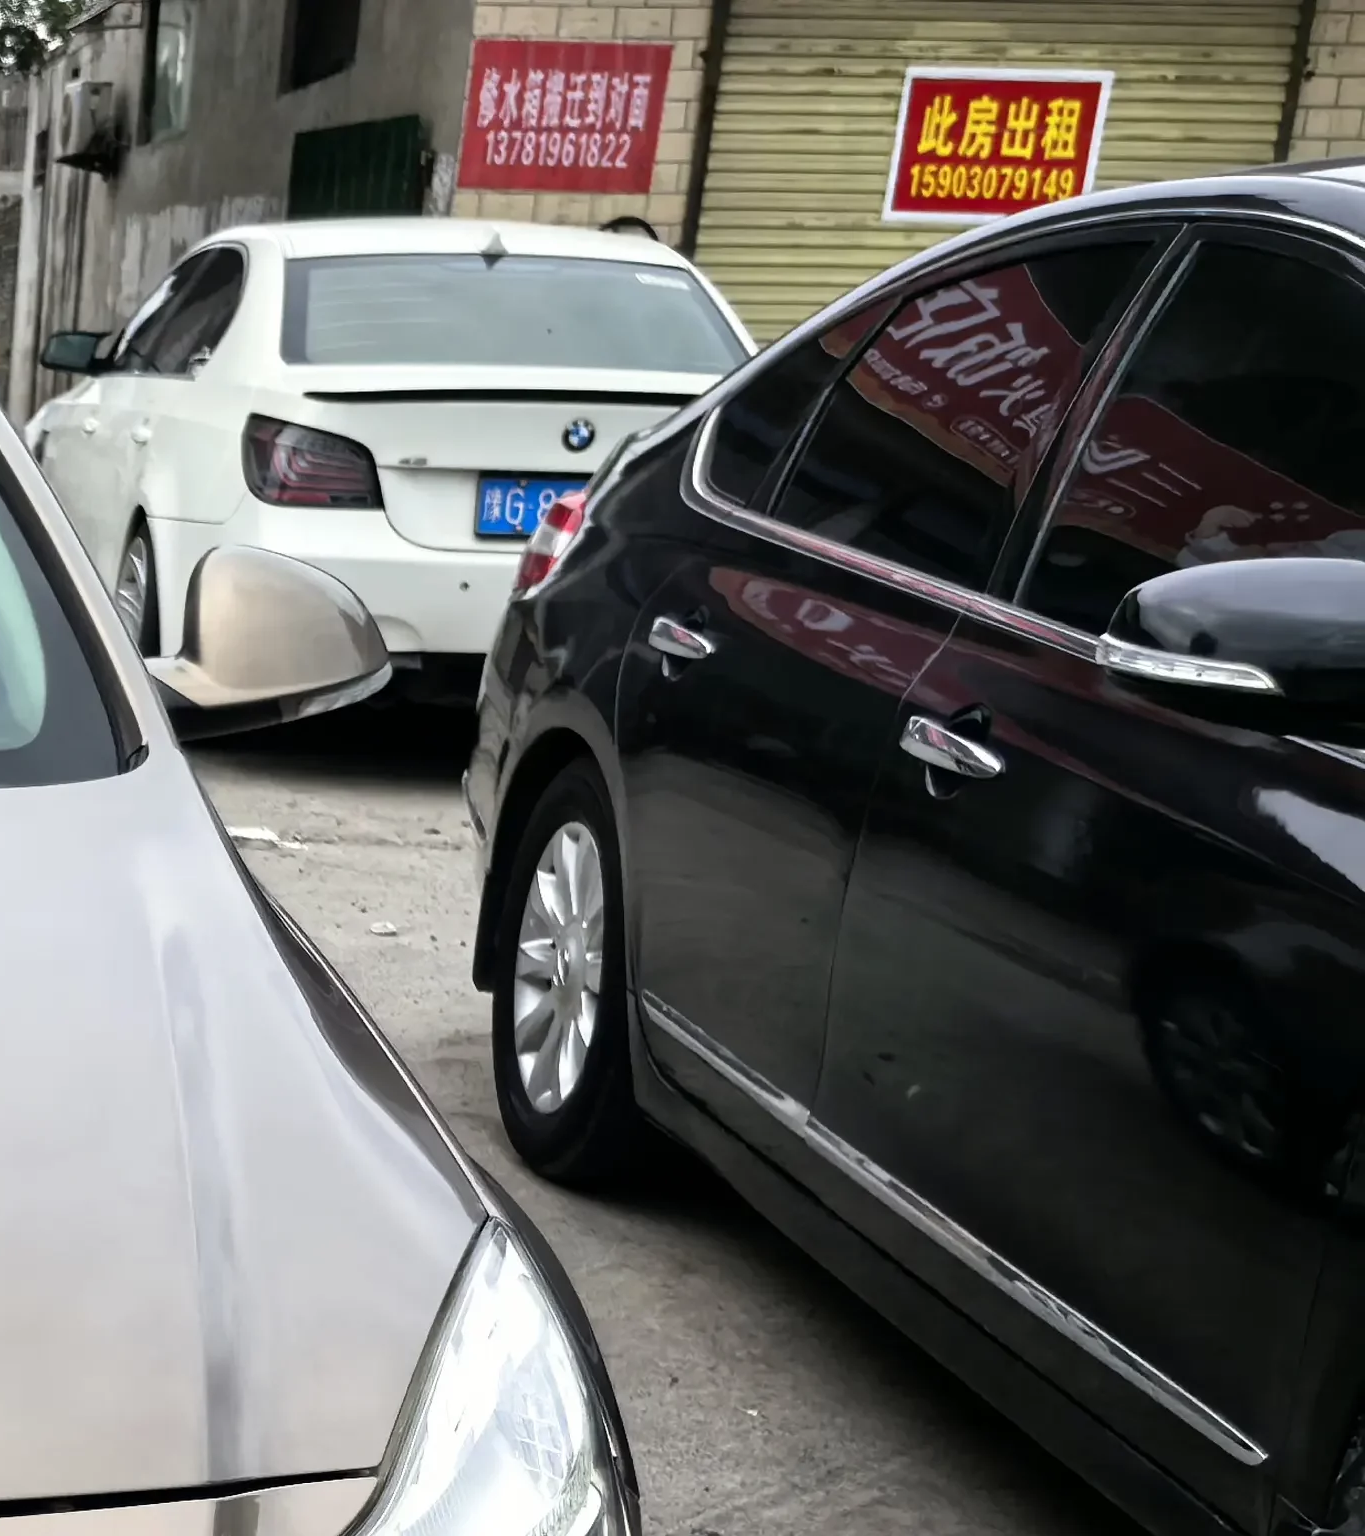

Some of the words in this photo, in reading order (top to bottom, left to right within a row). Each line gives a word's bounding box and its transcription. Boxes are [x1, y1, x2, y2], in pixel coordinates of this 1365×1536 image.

[917, 95, 1082, 160] 此房出租
[486, 130, 632, 168] 13781961822
[910, 164, 1074, 202] 15903079149
